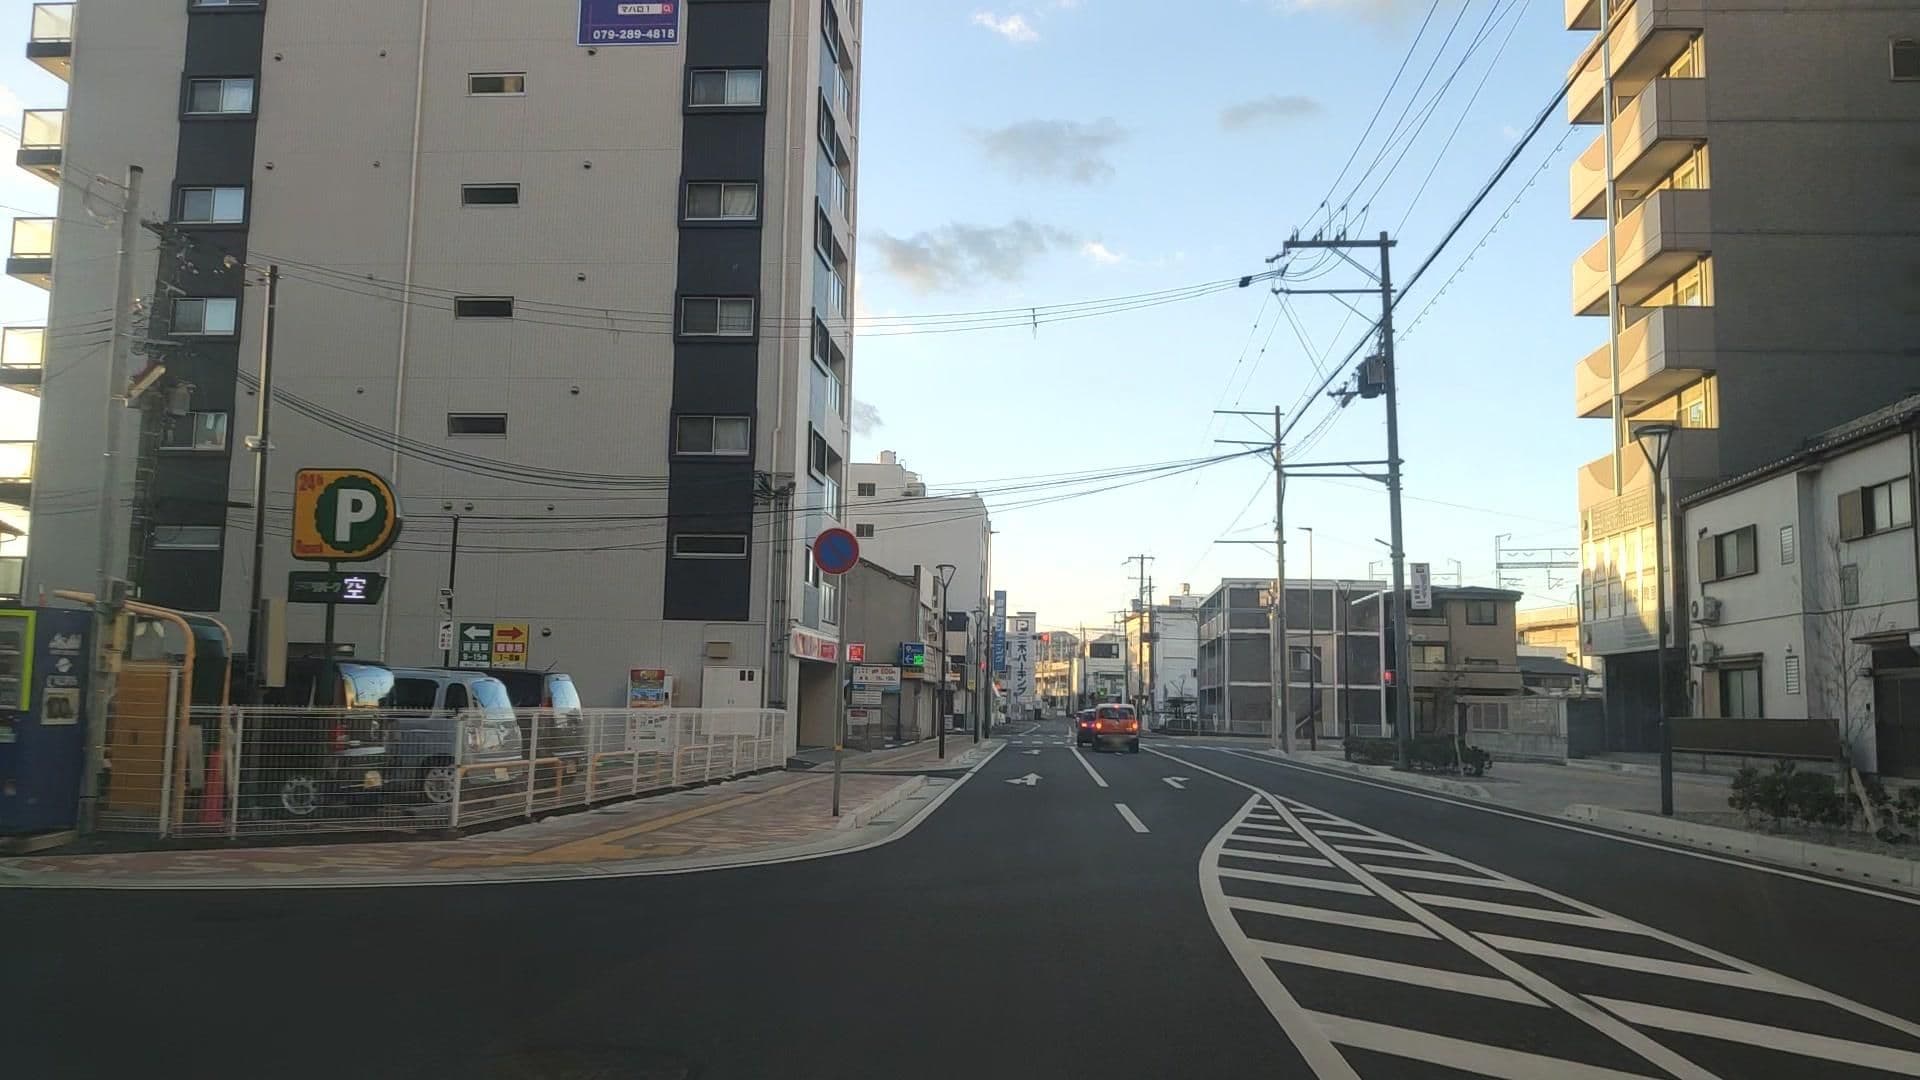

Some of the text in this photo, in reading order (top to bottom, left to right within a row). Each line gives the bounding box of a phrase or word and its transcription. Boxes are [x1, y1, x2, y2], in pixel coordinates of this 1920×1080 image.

[593, 29, 674, 39] 079-289-4818
[335, 488, 377, 542] P
[343, 576, 367, 599] 空
[1017, 621, 1028, 630] P
